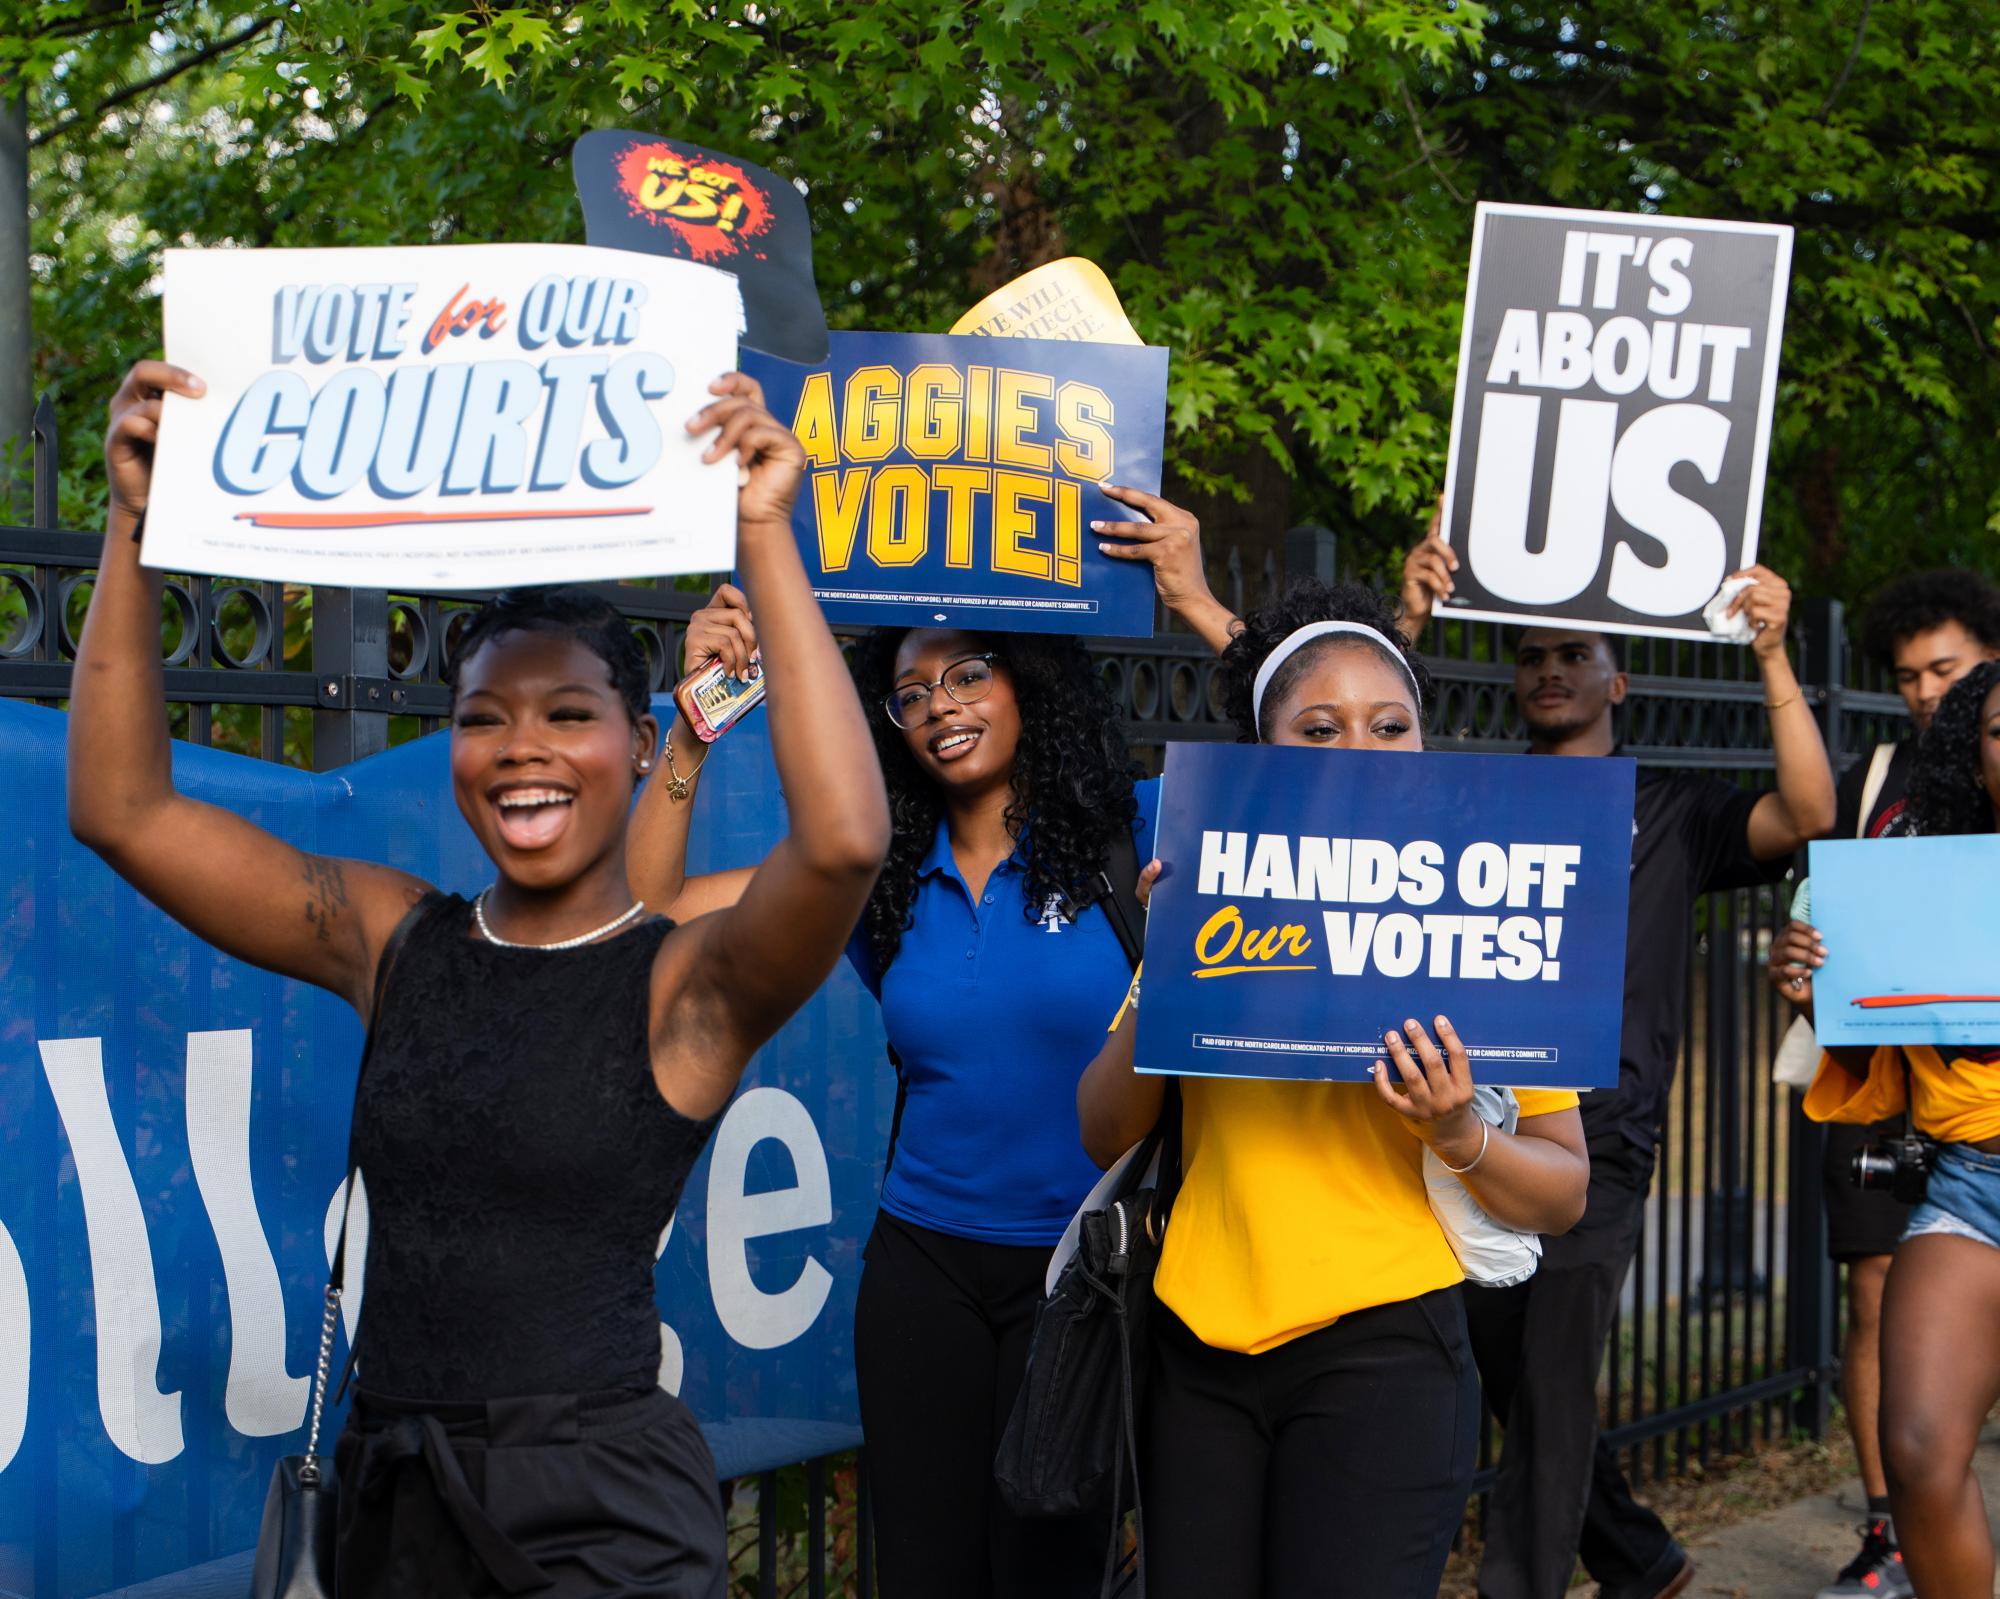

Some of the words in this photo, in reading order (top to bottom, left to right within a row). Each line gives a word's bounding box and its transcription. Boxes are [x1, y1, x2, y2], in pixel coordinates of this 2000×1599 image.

[640, 173, 743, 231] US!
[647, 157, 686, 176] WE
[689, 167, 735, 190] GOT
[1008, 281, 1071, 320] WILL
[1558, 230, 1694, 316] IT'S
[272, 282, 418, 365] VOTE
[421, 282, 507, 355] for
[518, 274, 648, 350] OUR
[1486, 308, 1751, 403] ABOUT
[212, 352, 676, 500] COURTS
[792, 364, 1115, 484] AGGIES
[812, 463, 1081, 588] VOTE!
[1468, 392, 1732, 617] US
[952, 597, 982, 605] AUTHORIZED
[999, 599, 1024, 607] CANDIDATE
[1197, 831, 1445, 906] HANDS
[1457, 842, 1581, 909] OFF
[1195, 905, 1312, 966] Our
[1323, 911, 1563, 982] VOTES!
[1226, 1039, 1234, 1047] BY
[1263, 1042, 1290, 1050] CAROLINA
